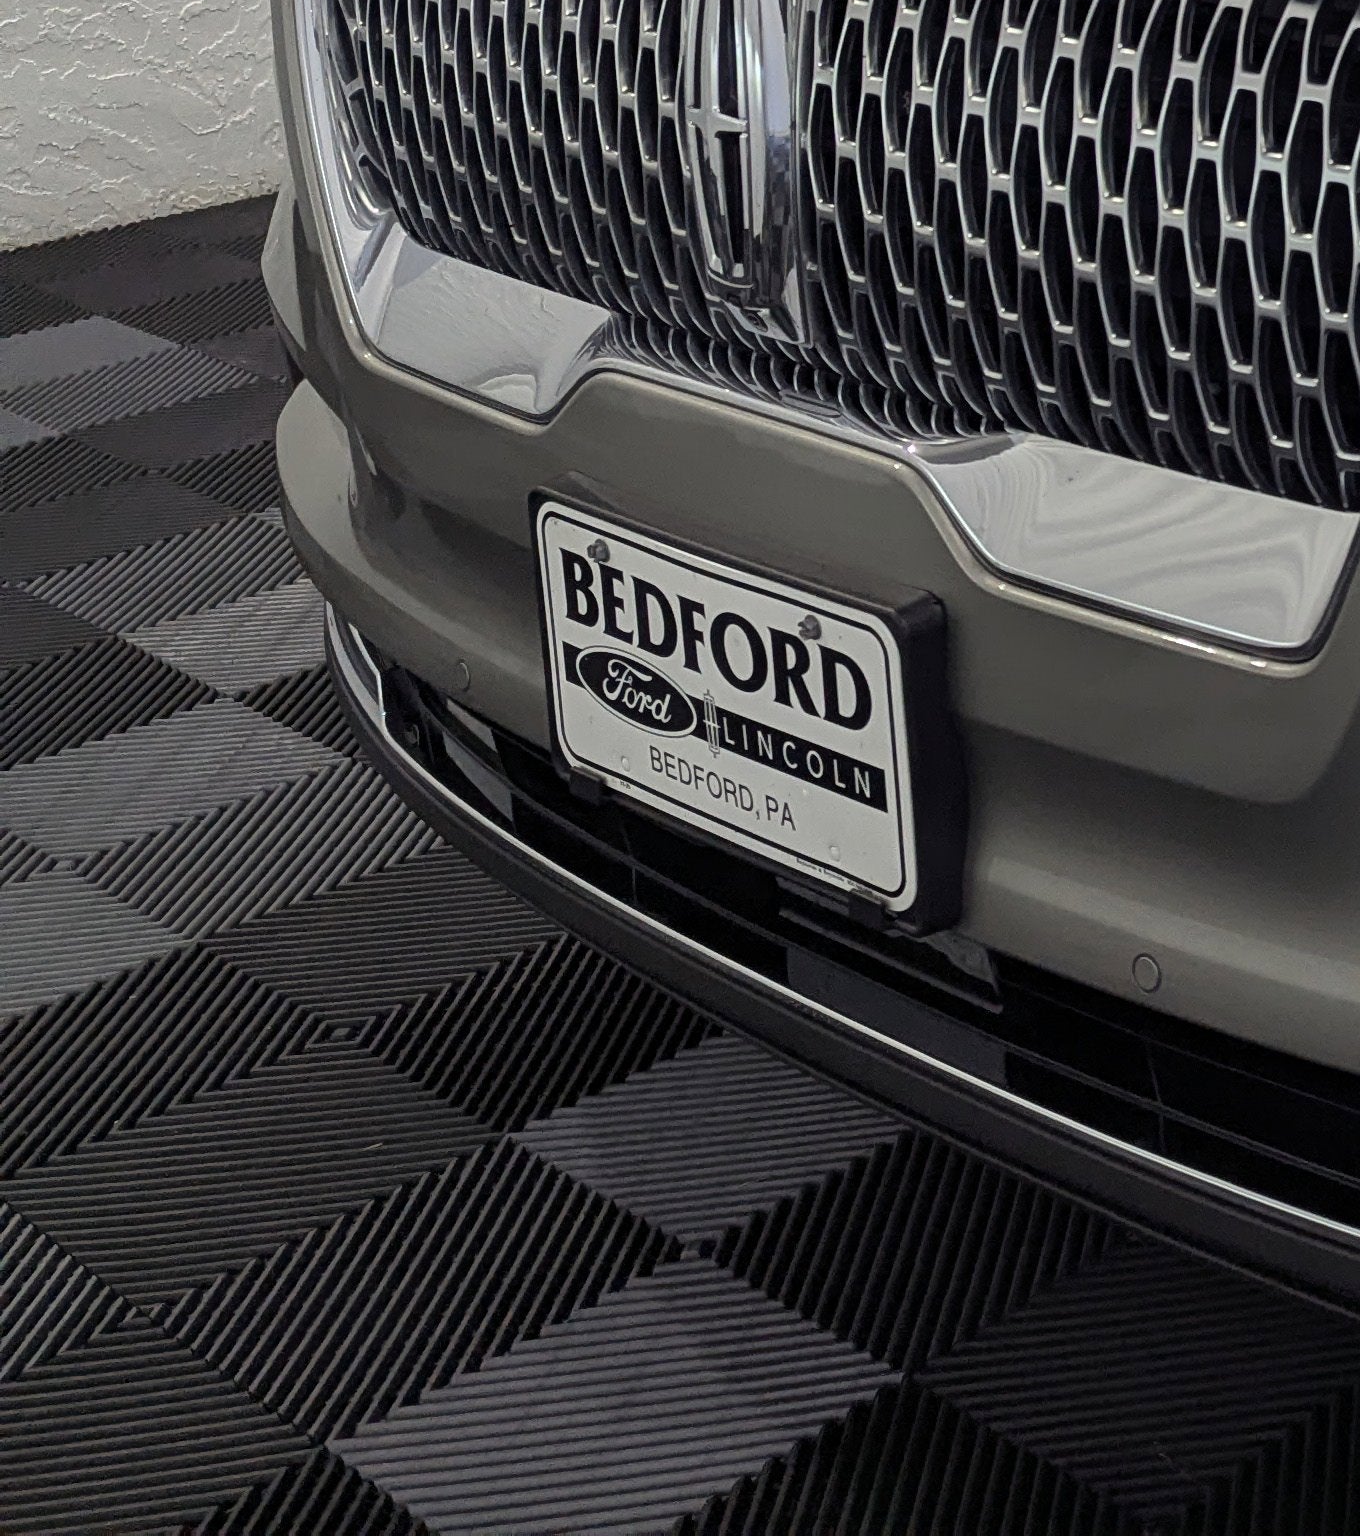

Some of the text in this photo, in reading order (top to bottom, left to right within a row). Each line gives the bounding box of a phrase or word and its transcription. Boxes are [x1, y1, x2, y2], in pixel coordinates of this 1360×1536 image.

[558, 547, 872, 732] BEDFORD
[602, 659, 672, 725] Ford
[723, 716, 871, 799] LINCOLN
[766, 794, 796, 832] PA
